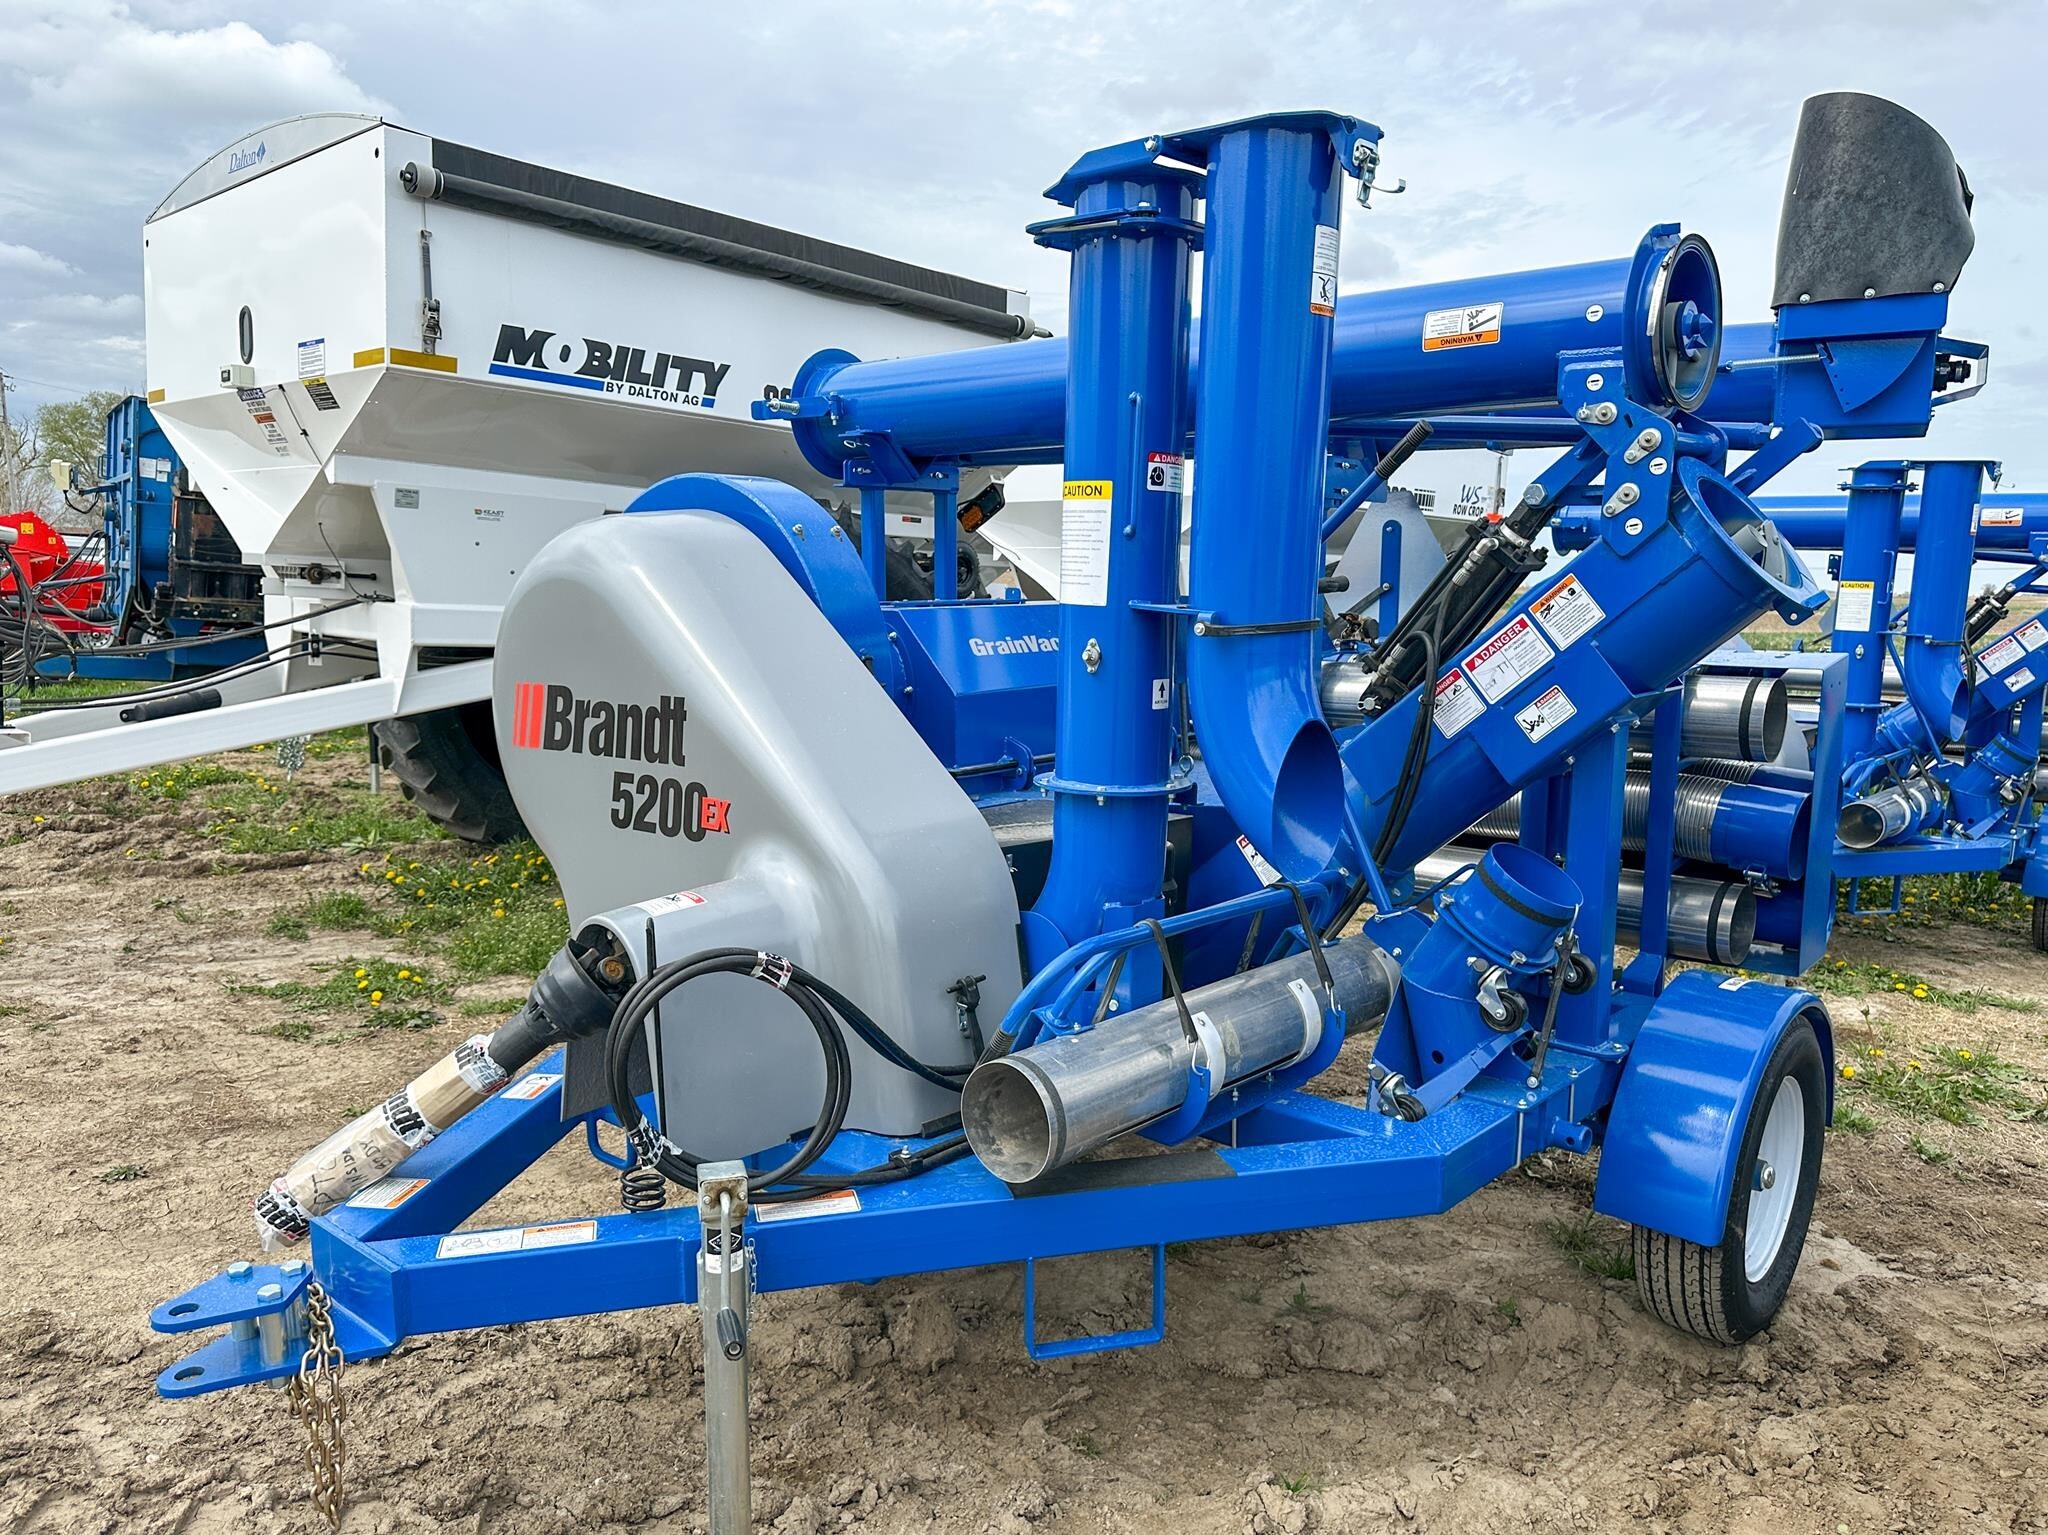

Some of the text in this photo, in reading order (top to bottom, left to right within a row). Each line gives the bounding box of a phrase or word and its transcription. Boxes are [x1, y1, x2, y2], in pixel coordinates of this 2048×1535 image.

[229, 149, 256, 171] Dalton
[1440, 336, 1474, 346] WARNING
[492, 324, 731, 395] MOBILITY
[606, 382, 700, 406] BY DALTON AG
[1063, 485, 1103, 497] CAUTION
[1460, 484, 1483, 504] WS
[1453, 504, 1484, 516] ROW CROP
[1543, 581, 1568, 603] WARNING
[968, 634, 1060, 657] GrainVac
[1480, 623, 1524, 660] DANGER
[543, 684, 687, 767] Brandt
